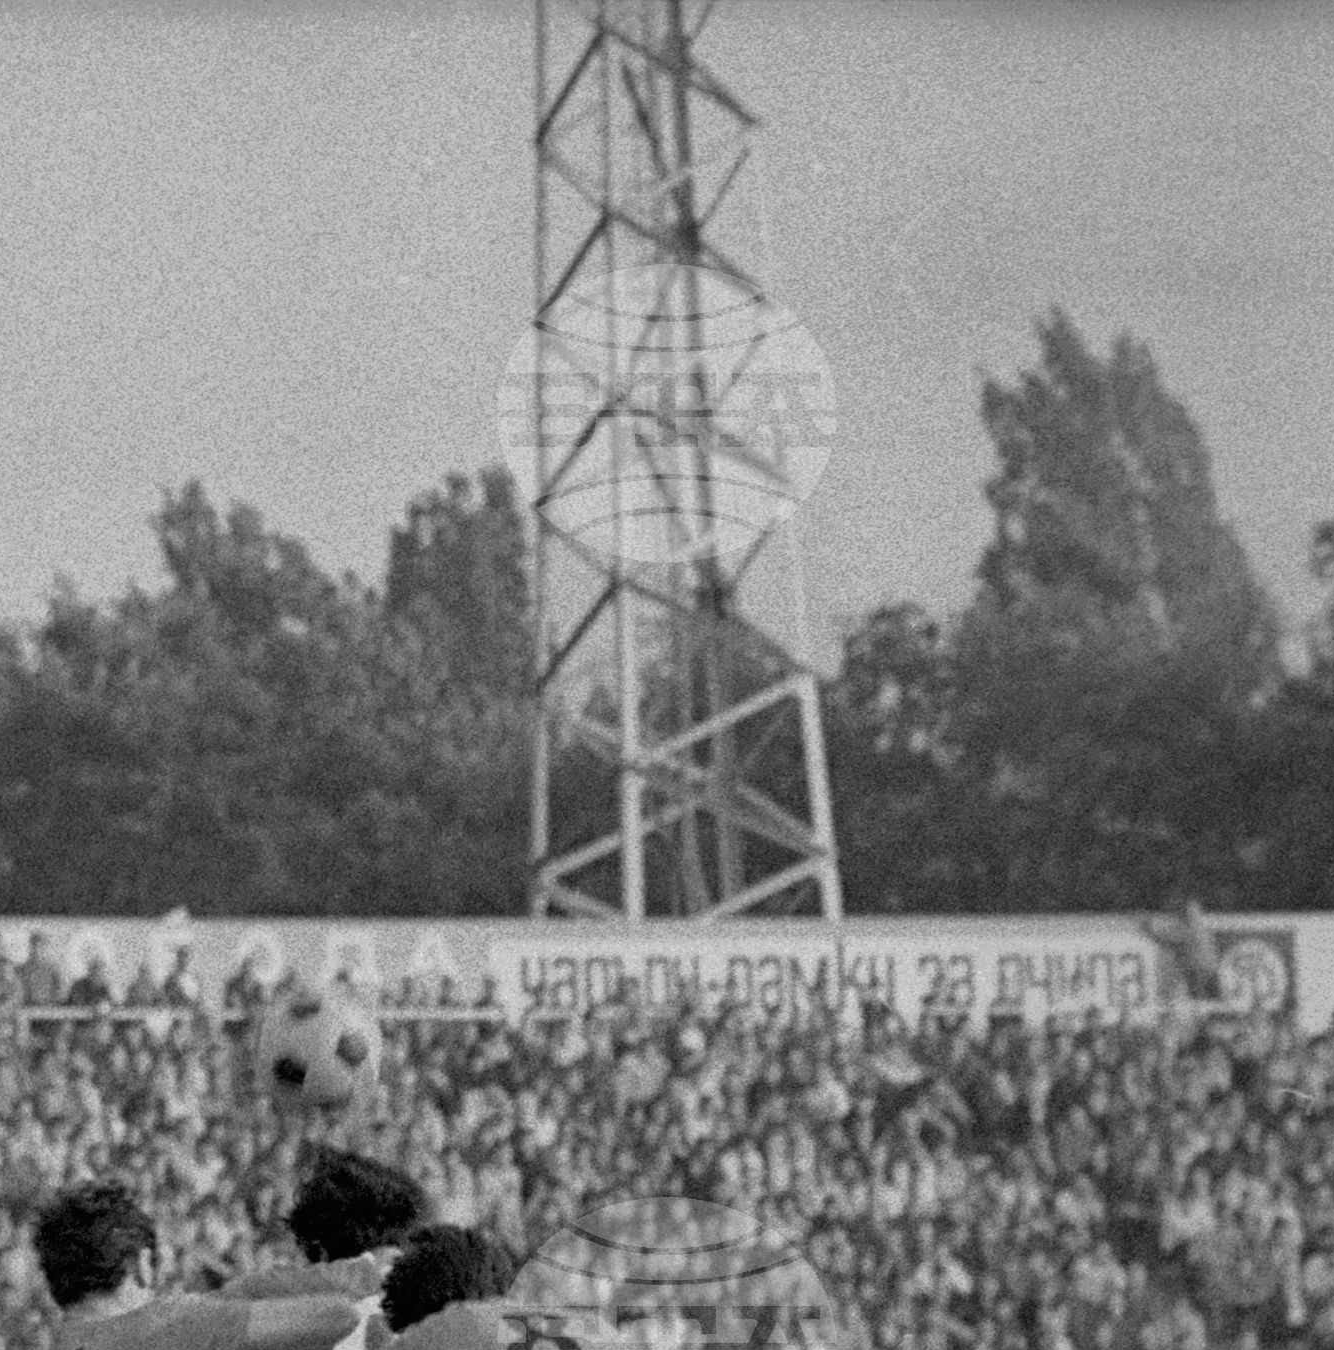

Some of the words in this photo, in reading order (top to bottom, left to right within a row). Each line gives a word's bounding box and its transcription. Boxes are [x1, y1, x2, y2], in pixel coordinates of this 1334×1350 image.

[727, 942, 897, 1010] рамки
[917, 953, 972, 1007] за
[995, 952, 1146, 1008] очила
